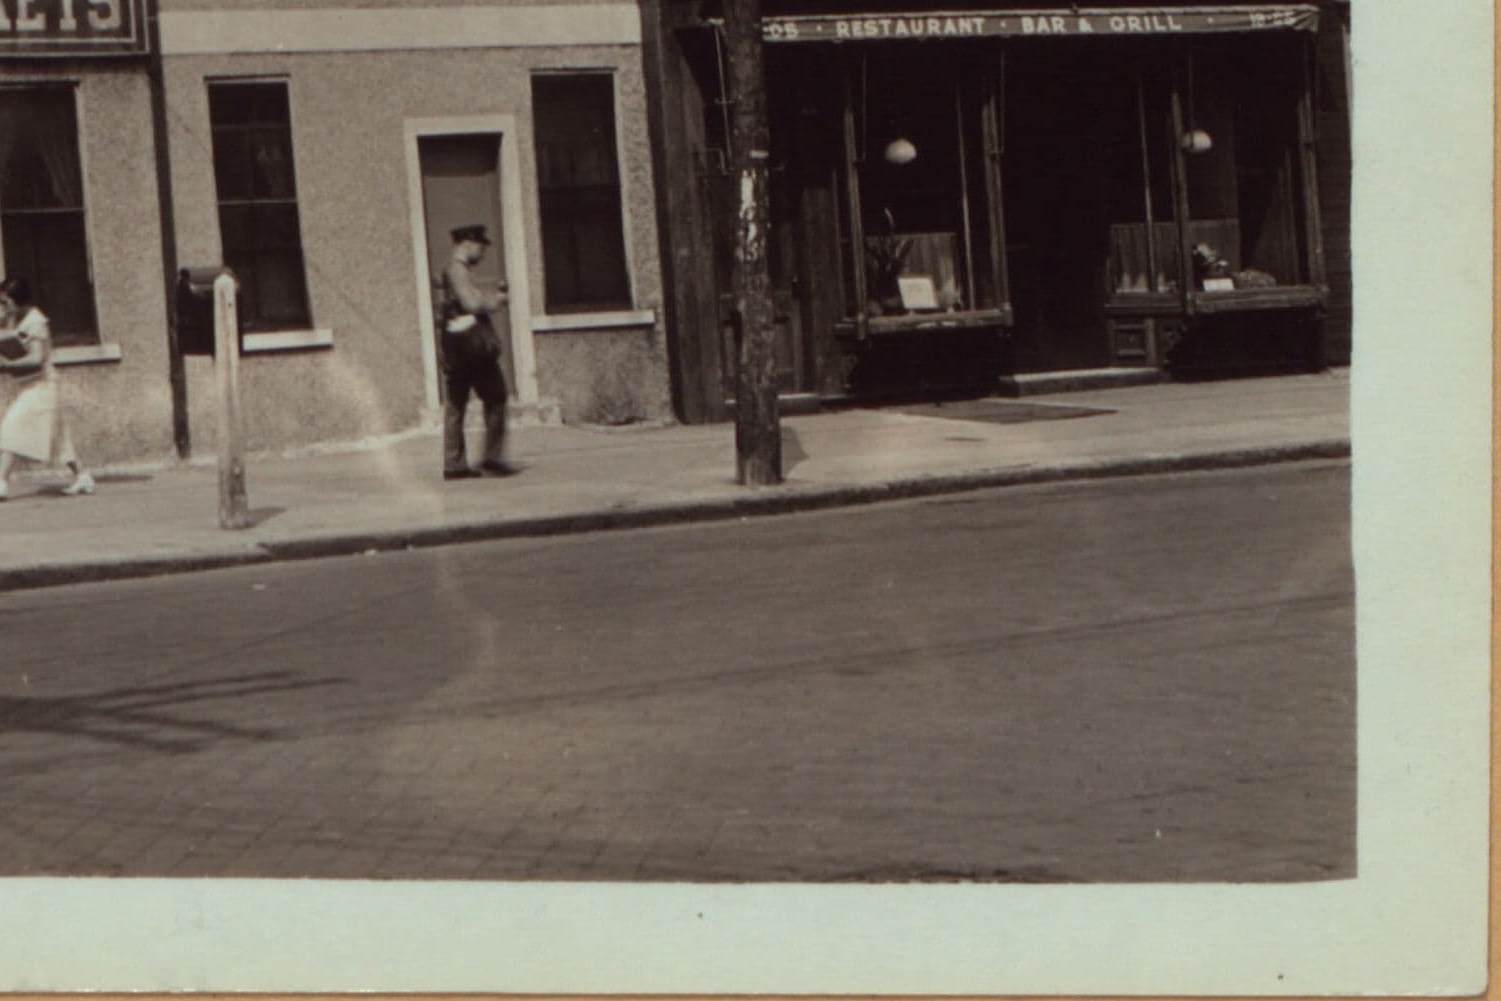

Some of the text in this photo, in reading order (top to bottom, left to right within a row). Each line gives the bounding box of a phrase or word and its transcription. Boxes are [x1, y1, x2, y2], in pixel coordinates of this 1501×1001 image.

[835, 17, 986, 39] RESTAURANT
[1021, 16, 1068, 35] BAR
[1078, 17, 1094, 34] &
[1109, 15, 1183, 33] GRILL
